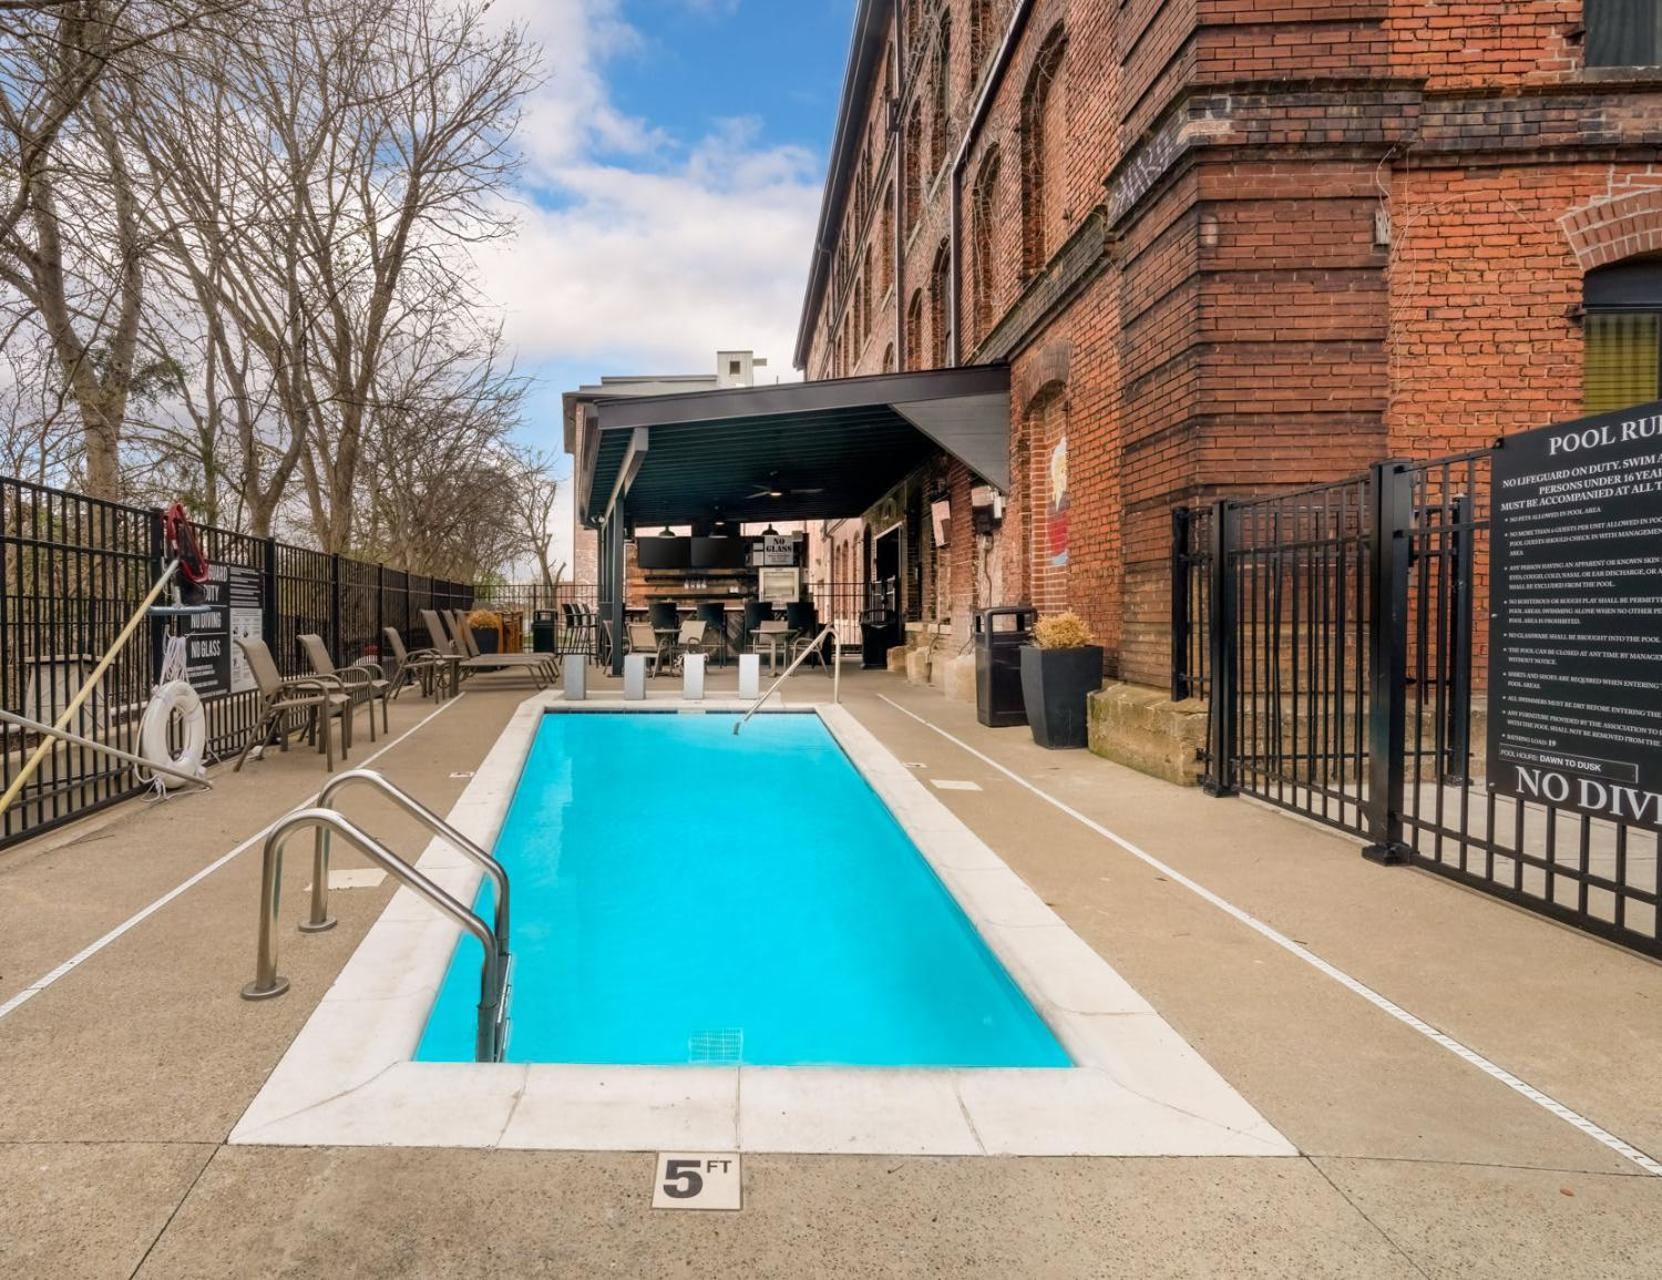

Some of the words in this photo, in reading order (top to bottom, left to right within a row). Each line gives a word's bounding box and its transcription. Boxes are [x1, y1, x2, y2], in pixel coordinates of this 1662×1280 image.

[1550, 426, 1616, 456] POOL
[1502, 478, 1516, 488] NO
[1516, 468, 1570, 486] LIFEGUARD
[1570, 466, 1587, 477] ON
[1588, 460, 1621, 474] DUTY.
[1622, 454, 1655, 469] SWIM
[1538, 480, 1582, 495] PERSONS
[1584, 474, 1621, 488] UNDER
[1624, 472, 1634, 482] 16
[1500, 500, 1525, 511] MUST
[1526, 498, 1538, 508] BE
[1538, 488, 1614, 506] ACCOMPANIED
[1614, 485, 1630, 496] AT
[1630, 482, 1654, 494] ALL
[1567, 508, 1583, 516] POOL
[1606, 518, 1640, 528] ALLOWED
[1640, 516, 1648, 525] IN
[766, 544, 792, 552] GLASS
[200, 612, 222, 628] DIVING
[191, 640, 200, 658] NO
[201, 640, 221, 658] GLASS
[1500, 749, 1516, 758] POOL
[1540, 755, 1564, 766] DAWN
[1564, 758, 1576, 768] TO
[1578, 760, 1602, 773] DUSK
[1515, 766, 1569, 802] NO
[663, 1160, 704, 1199] 5
[706, 1160, 732, 1174] FT
